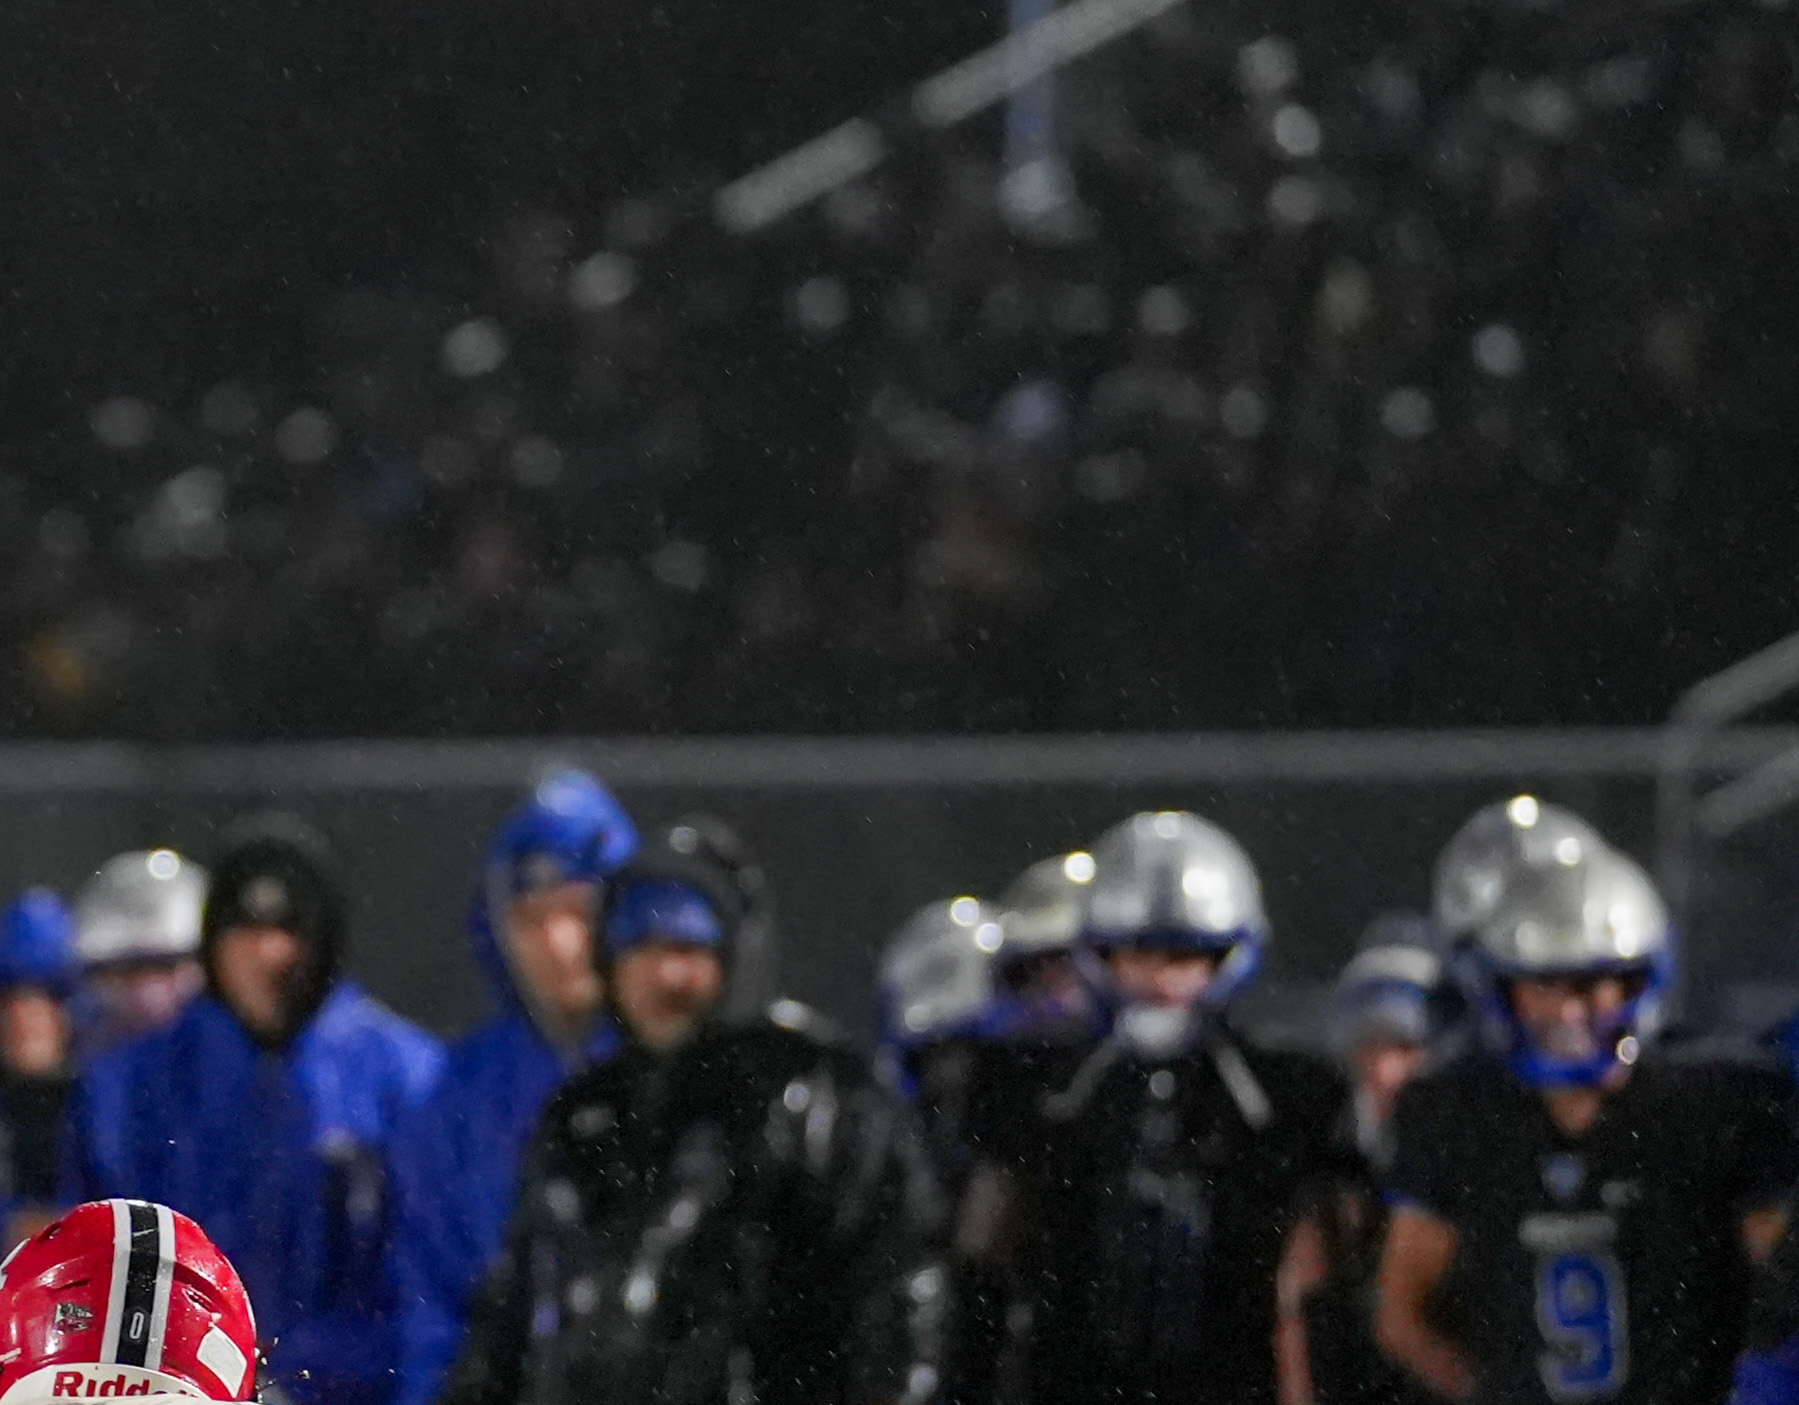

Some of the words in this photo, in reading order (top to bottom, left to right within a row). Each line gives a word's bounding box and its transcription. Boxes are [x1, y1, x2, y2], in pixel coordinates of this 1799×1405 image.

[129, 1311, 144, 1340] 0
[1535, 1249, 1631, 1405] 9
[53, 1371, 200, 1397] Ridd
